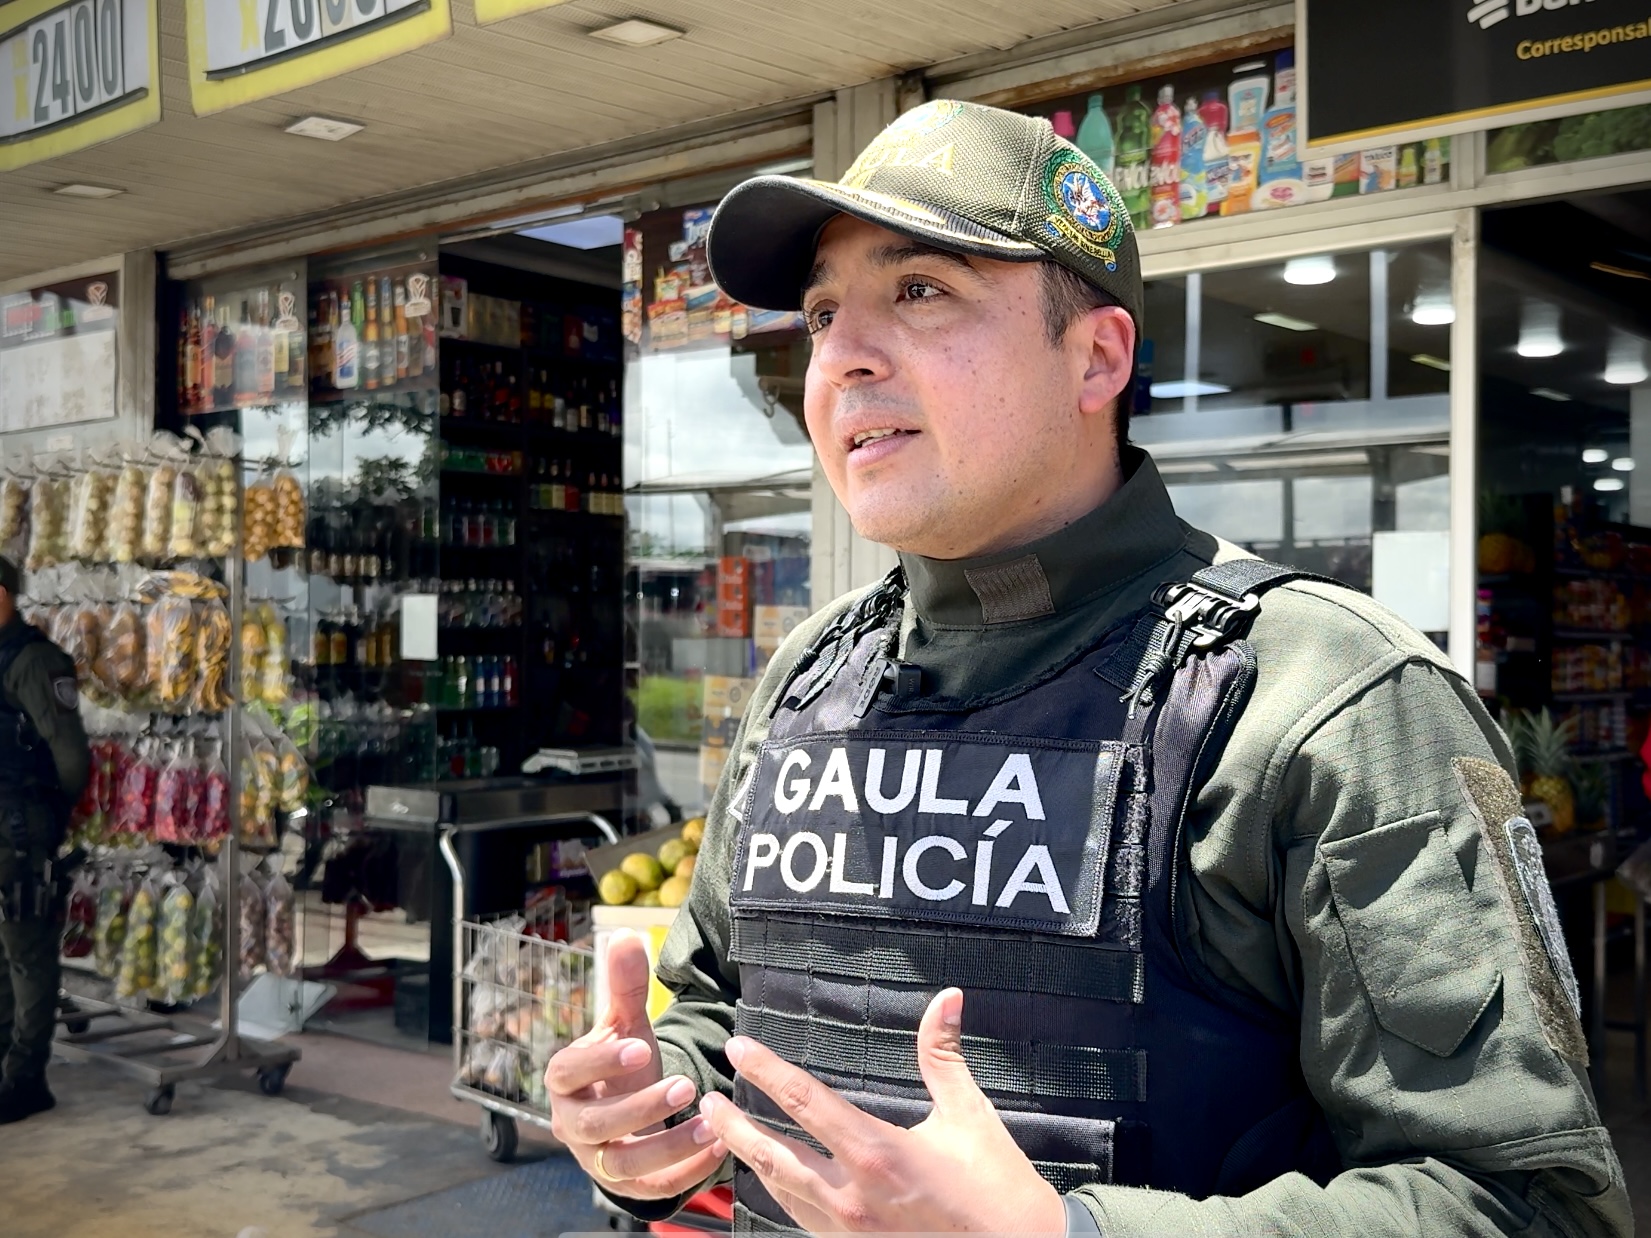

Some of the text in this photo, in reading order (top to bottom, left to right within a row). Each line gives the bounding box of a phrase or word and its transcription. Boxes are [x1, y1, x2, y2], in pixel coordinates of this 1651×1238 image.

[32, 0, 123, 124] 2400
[1516, 17, 1651, 60] Corresponsal
[773, 747, 1046, 821] GAULA
[741, 820, 1071, 914] POLICÍA
